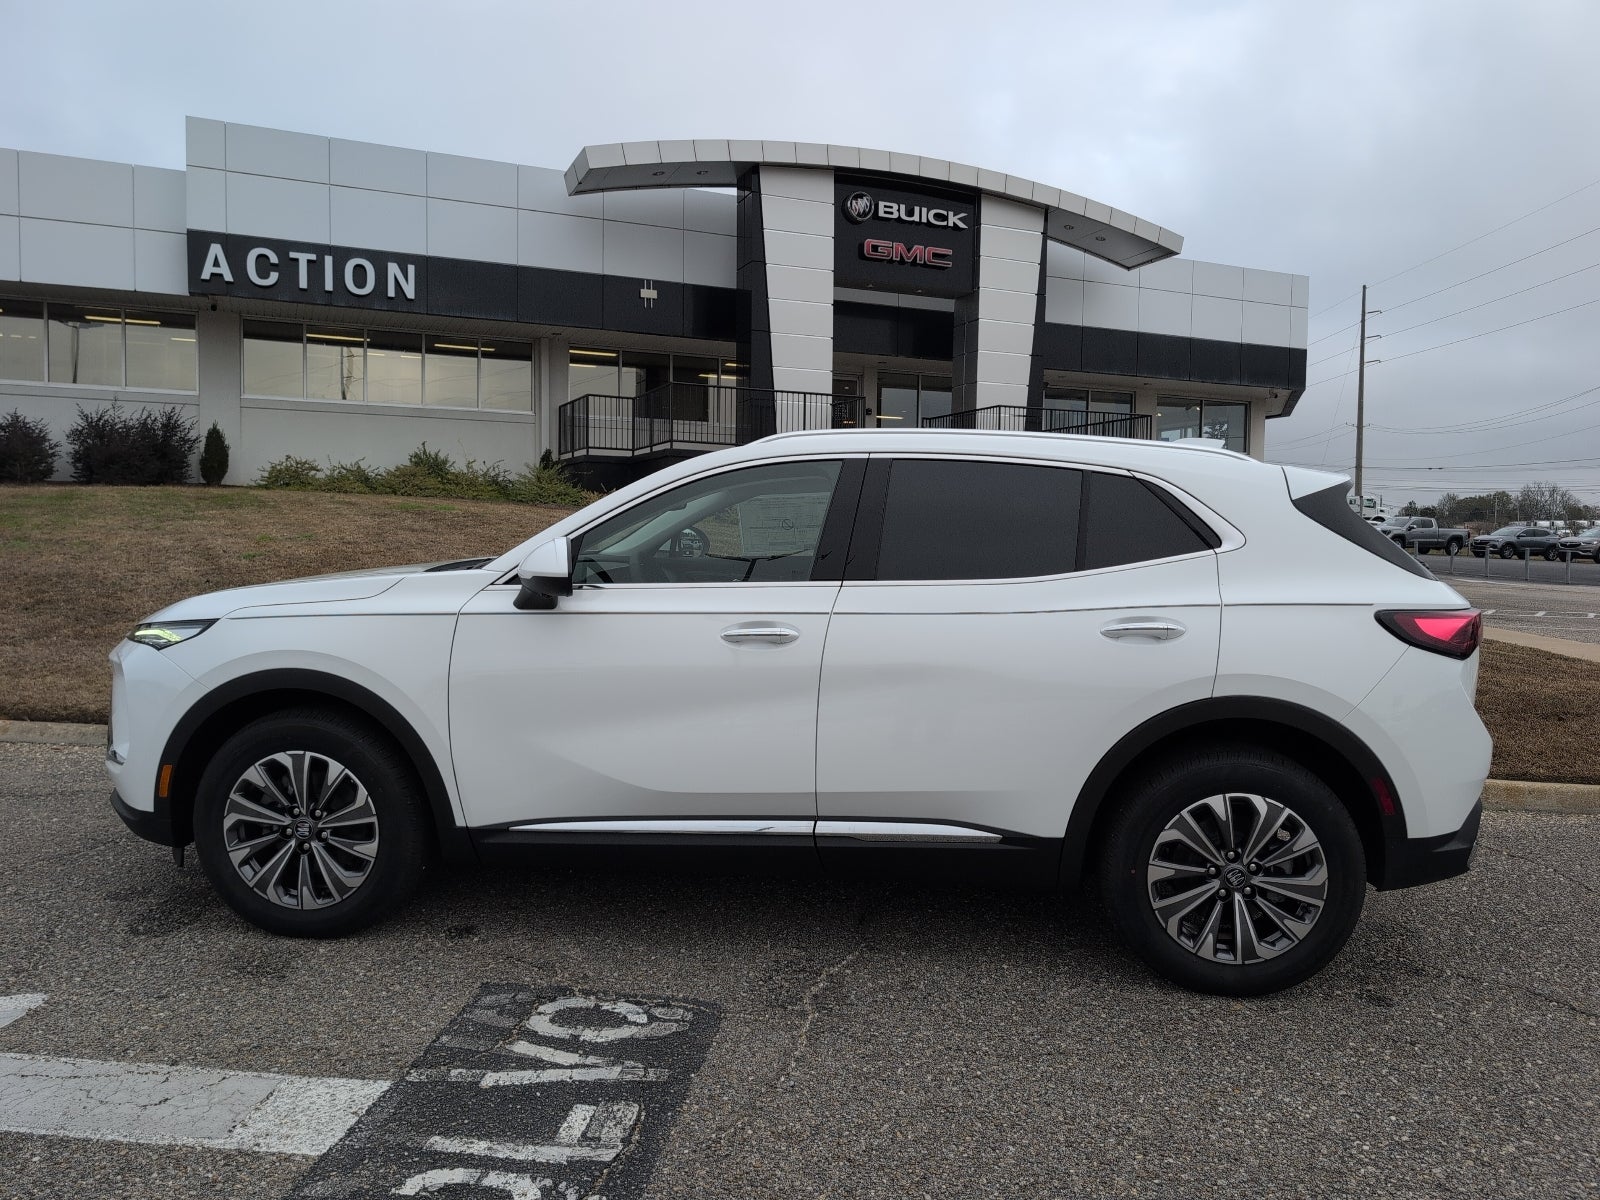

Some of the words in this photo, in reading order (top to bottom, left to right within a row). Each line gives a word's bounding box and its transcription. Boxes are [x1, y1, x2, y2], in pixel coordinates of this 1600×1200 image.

[878, 200, 968, 229] BUICK
[864, 238, 952, 267] GMC
[200, 242, 415, 300] ACTION
